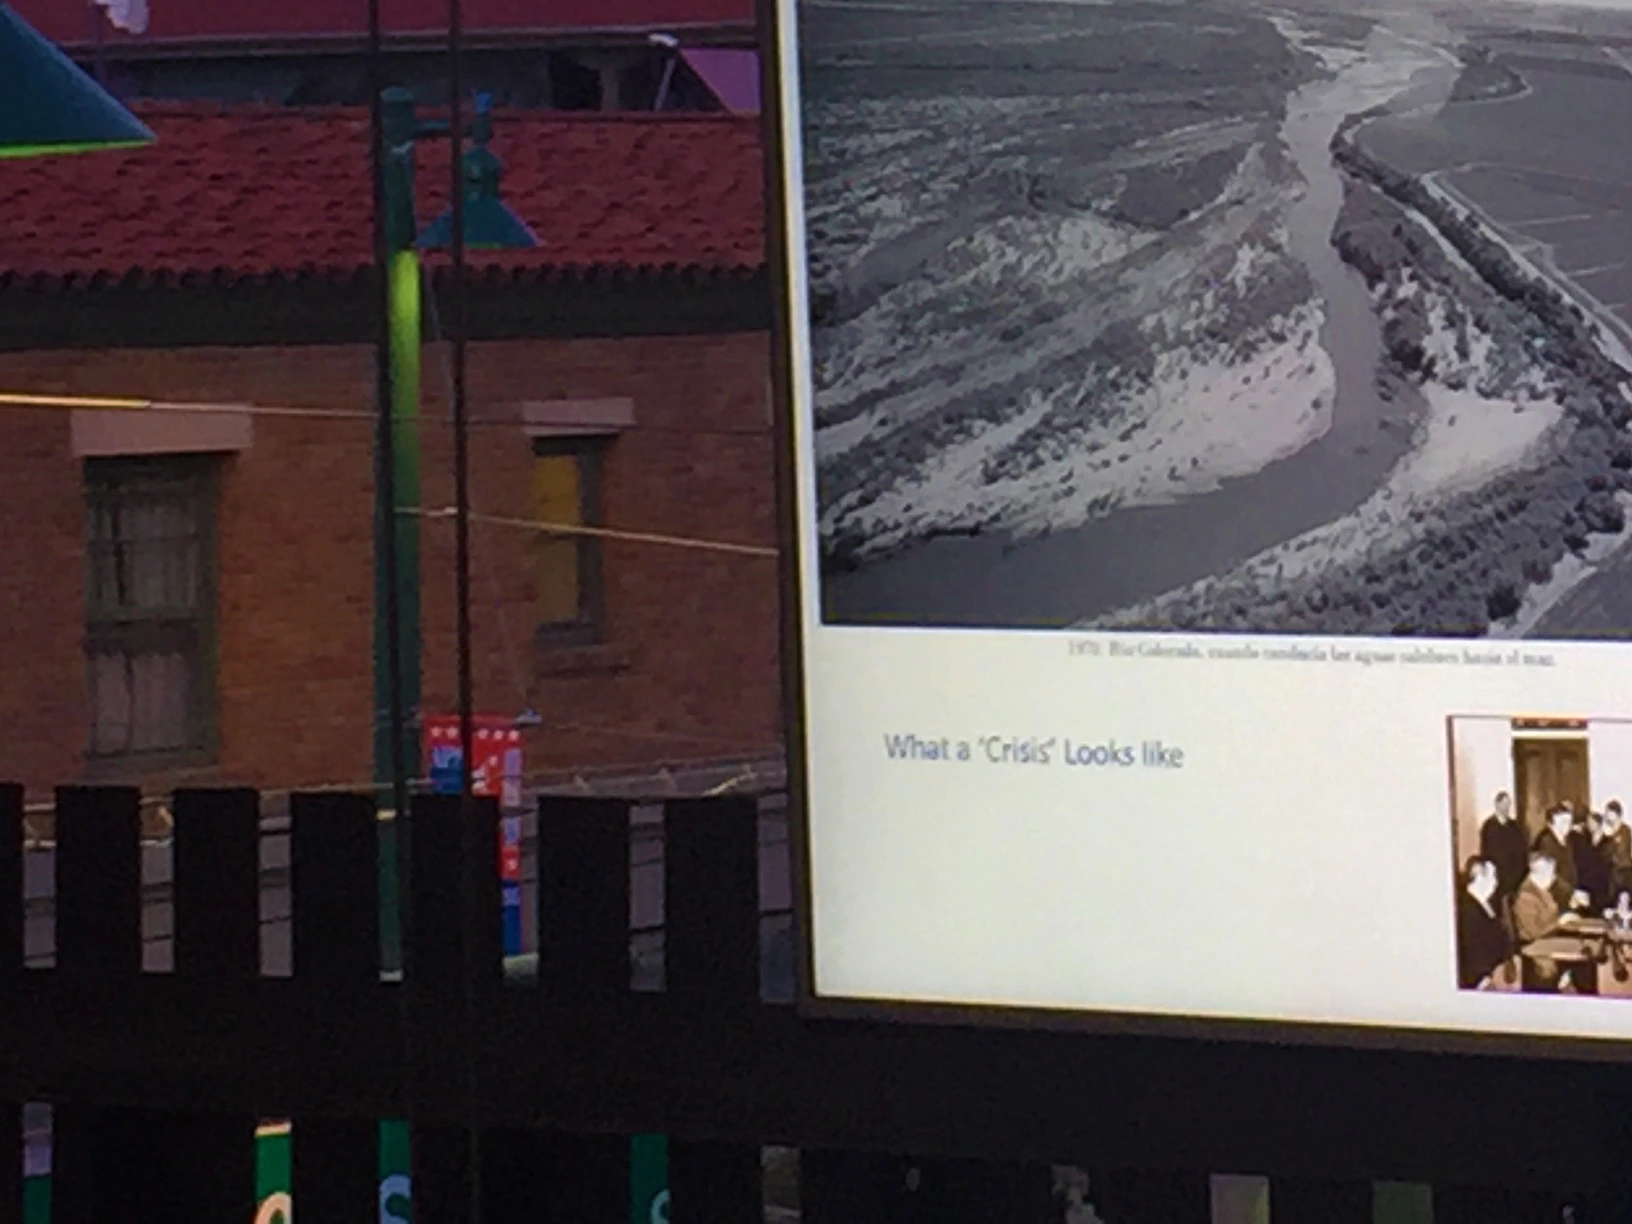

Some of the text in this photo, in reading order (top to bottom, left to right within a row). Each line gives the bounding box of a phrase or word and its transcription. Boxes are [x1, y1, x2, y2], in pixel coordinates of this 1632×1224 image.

[884, 732, 1185, 769] What a 'Crisis' Looks like
